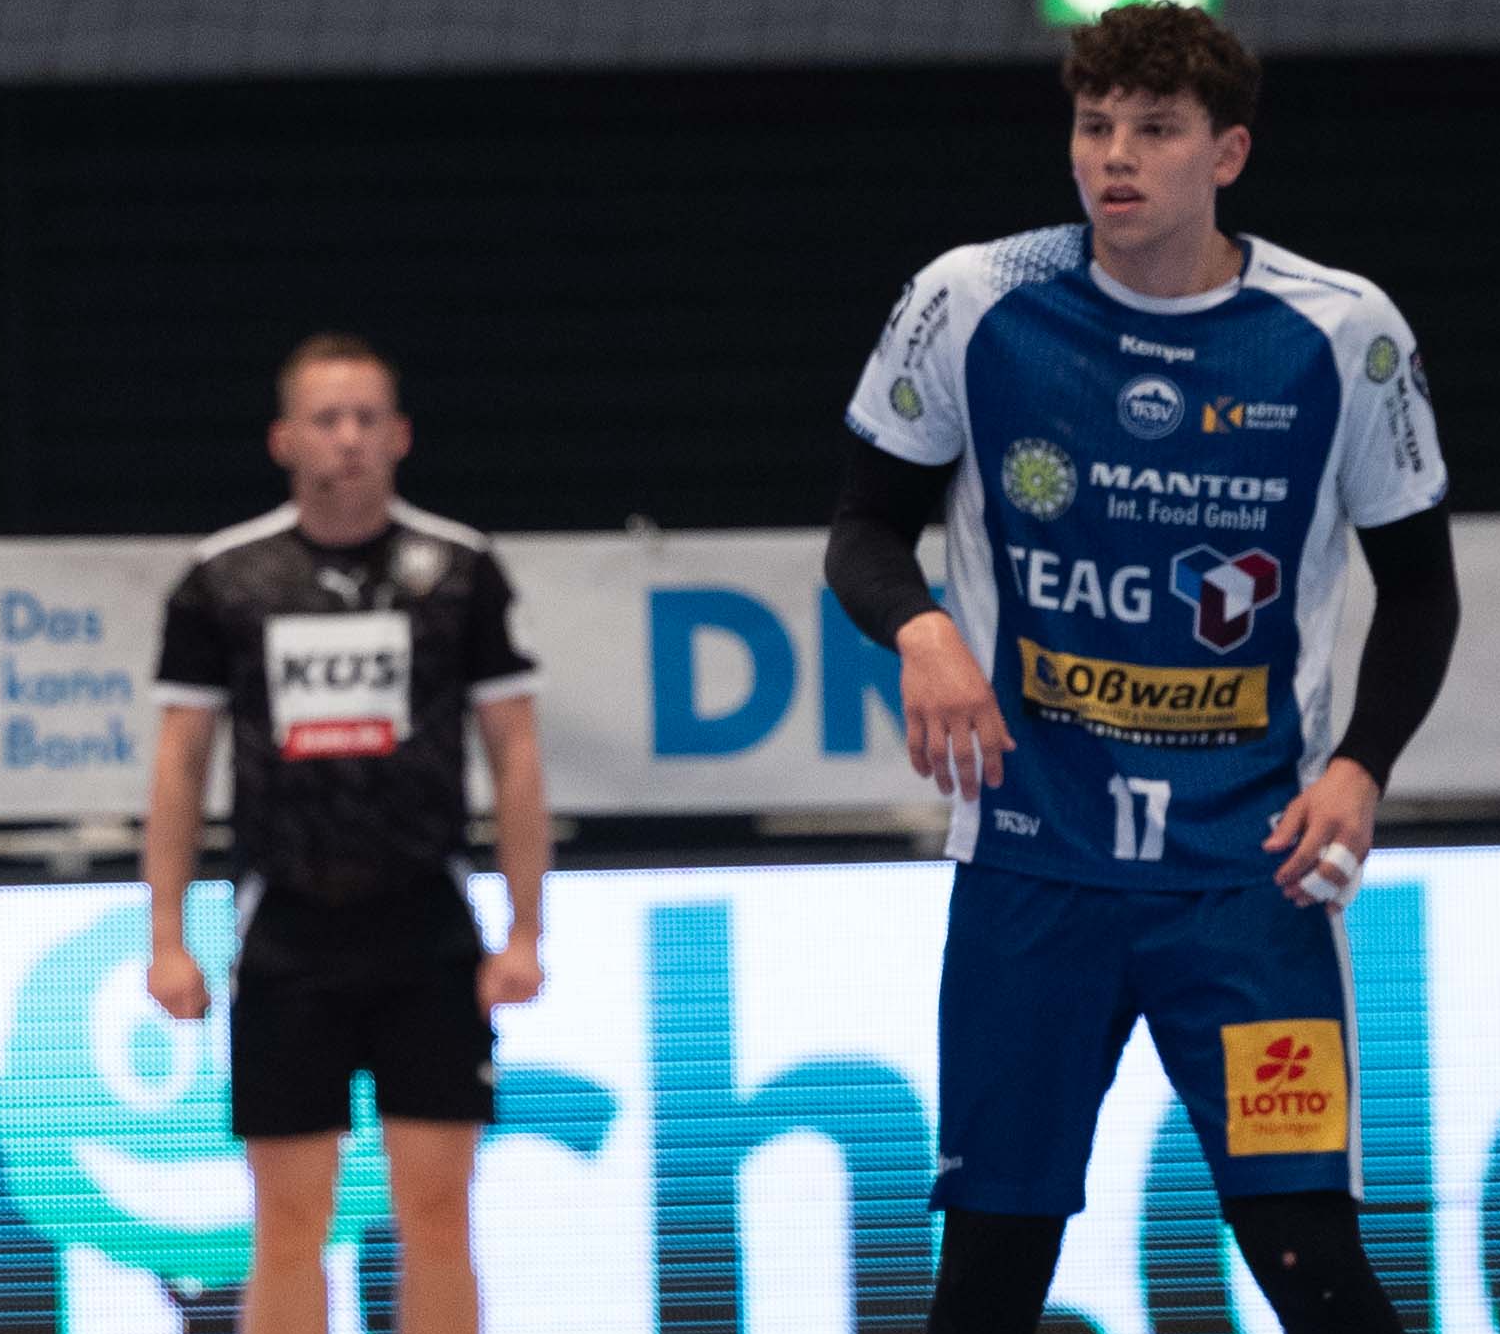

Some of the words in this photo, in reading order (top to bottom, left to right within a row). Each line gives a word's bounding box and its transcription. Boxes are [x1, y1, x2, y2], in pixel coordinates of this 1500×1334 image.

[1119, 334, 1195, 363] Kempa
[1089, 462, 1288, 502] MANTOS
[1107, 493, 1142, 521] Int.
[1148, 498, 1199, 526] Food
[1203, 503, 1268, 531] GmbH
[2, 591, 103, 644] Das
[3, 653, 132, 706] kann
[1066, 664, 1244, 711] Oßwald
[6, 717, 135, 771] Bank
[1108, 774, 1171, 861] 17
[1240, 1089, 1327, 1117] LOTTO
